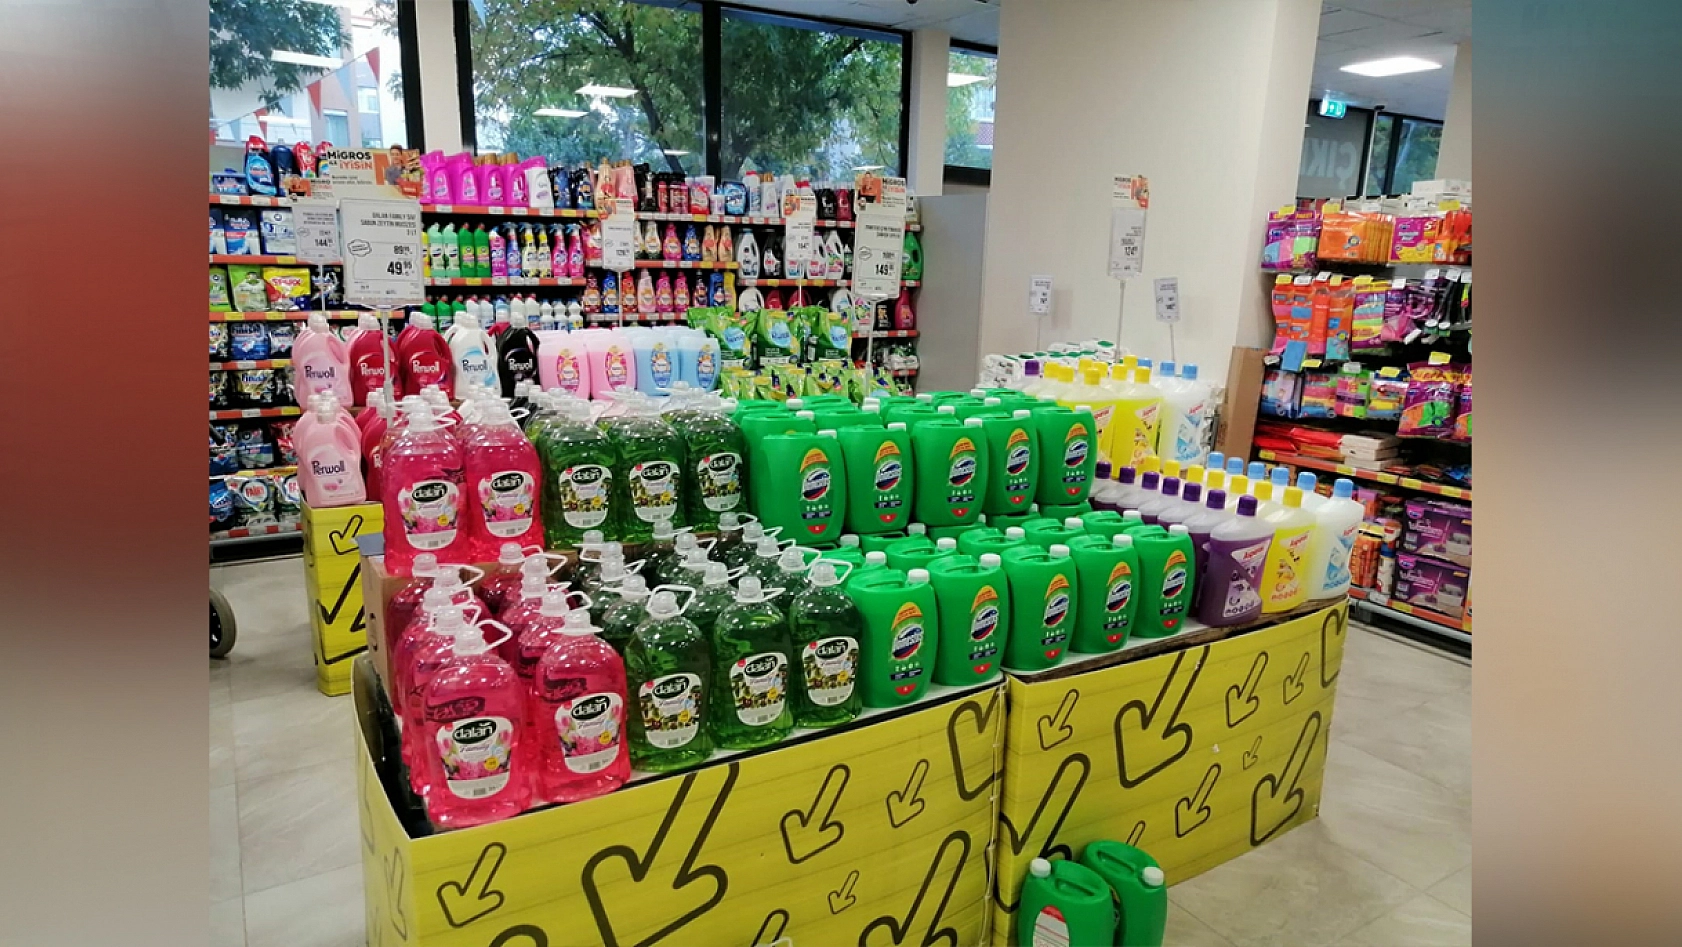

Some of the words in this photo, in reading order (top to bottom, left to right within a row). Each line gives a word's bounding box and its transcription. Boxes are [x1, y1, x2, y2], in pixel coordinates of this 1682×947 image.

[304, 365, 335, 379] Perwoll
[360, 363, 384, 376] Perwo
[311, 460, 345, 475] Perwoll
[572, 699, 608, 716] dalan
[454, 722, 493, 739] dalan
